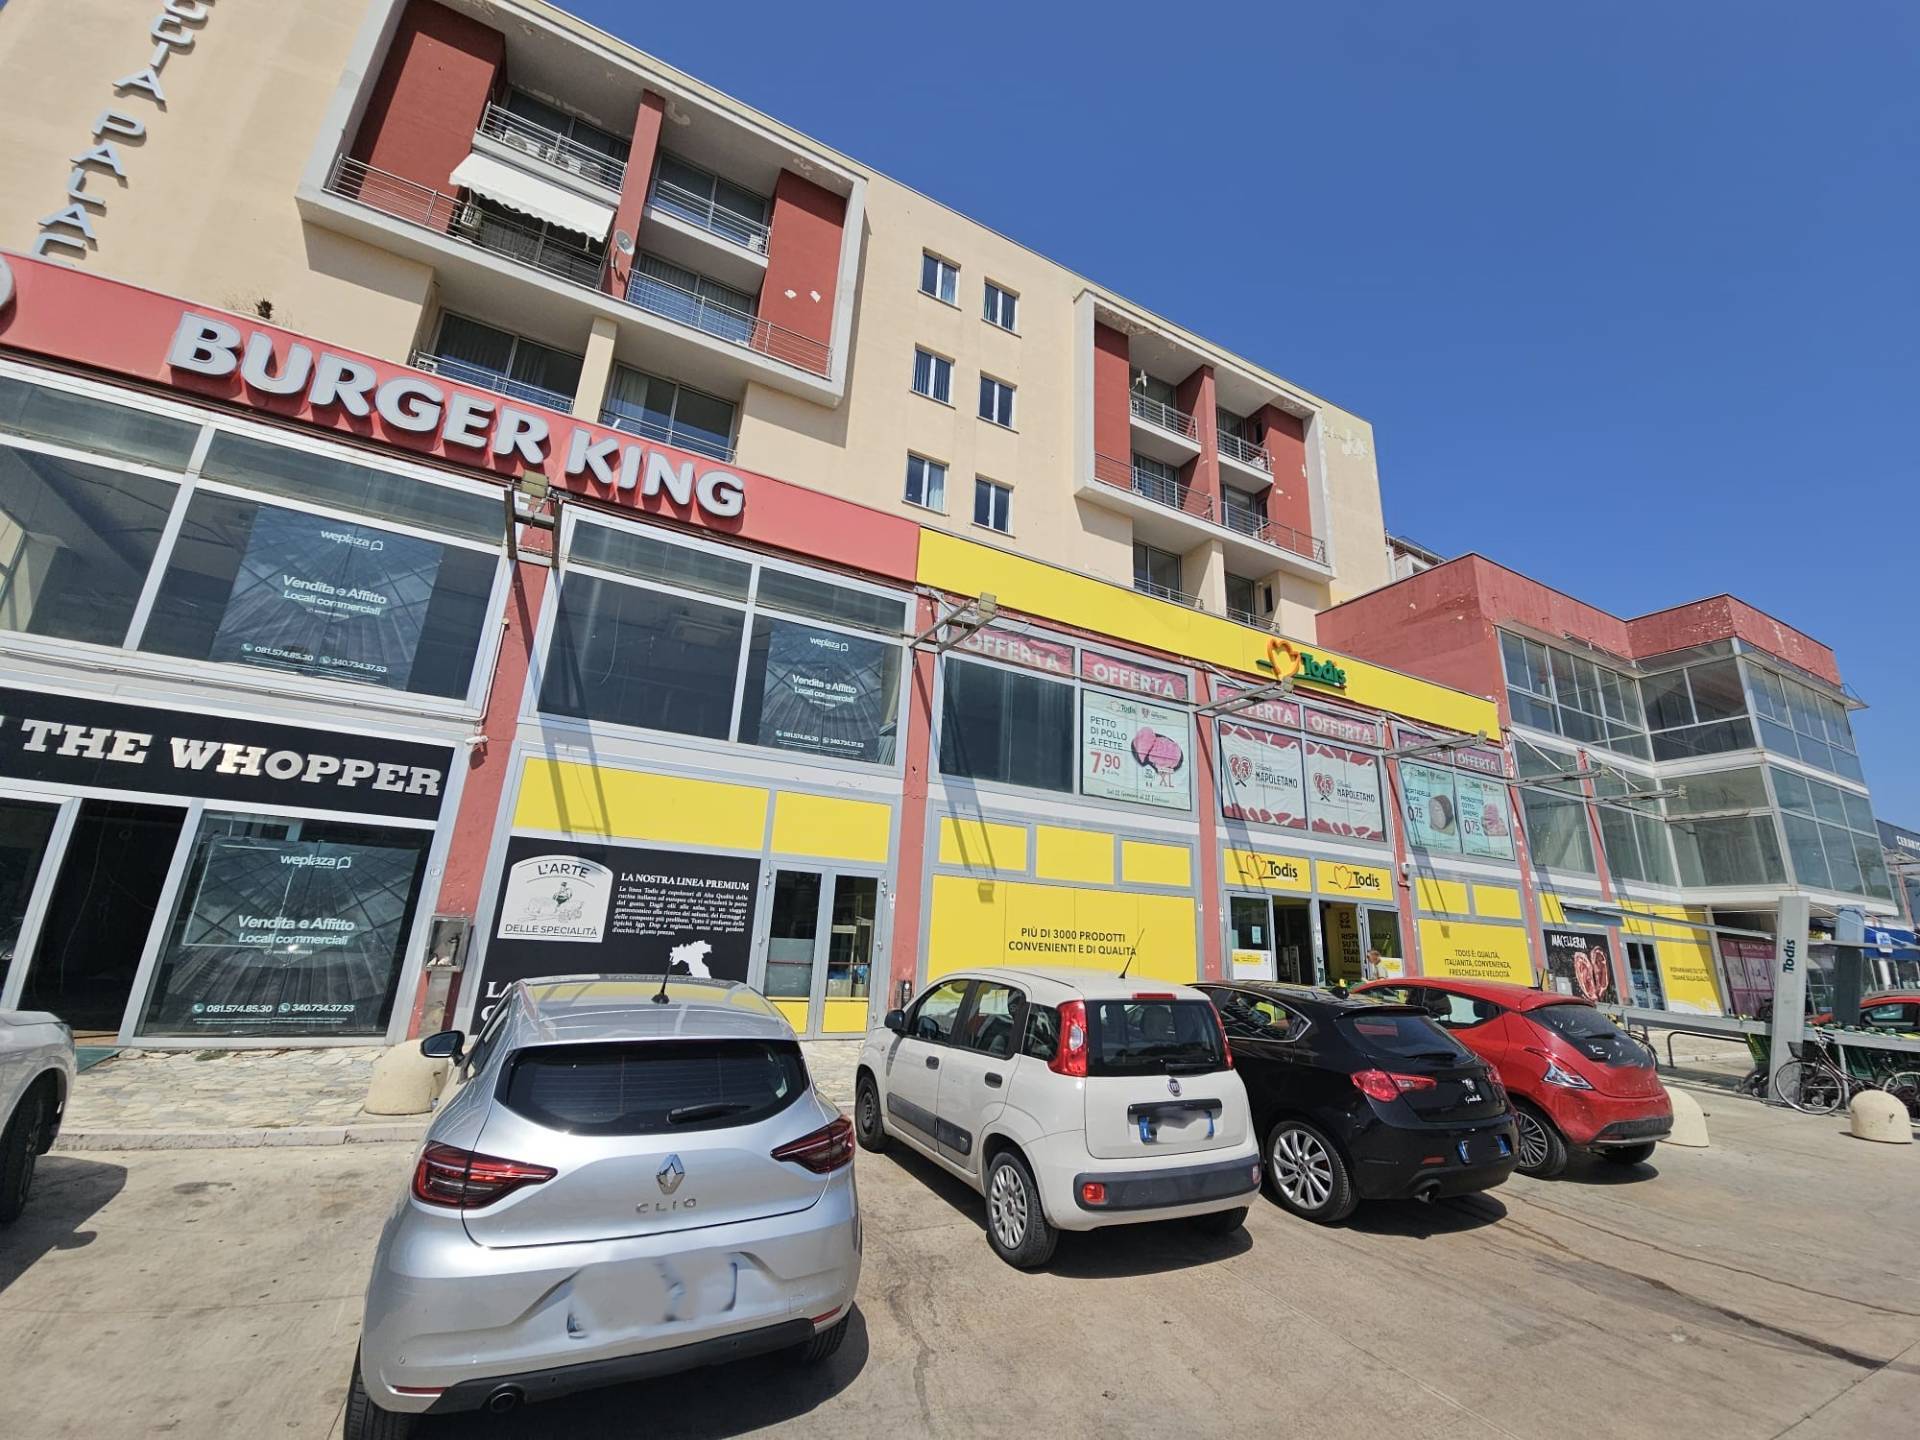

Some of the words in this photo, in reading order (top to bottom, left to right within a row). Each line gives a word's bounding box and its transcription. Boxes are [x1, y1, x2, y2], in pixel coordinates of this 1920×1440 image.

[166, 311, 551, 465] BURGER
[565, 427, 746, 519] KING
[320, 530, 370, 546] weplaza
[283, 575, 335, 595] Vendita
[336, 587, 346, 597] e
[347, 588, 388, 605] Affitto
[283, 590, 316, 604] Locali
[316, 597, 382, 616] commerciali
[809, 637, 840, 649] weplaza
[964, 633, 1061, 673] OFFERTA
[1299, 652, 1346, 685] Todis
[792, 674, 824, 689] Vendita
[831, 683, 857, 694] Affitto
[1094, 662, 1176, 698] OFFERTA
[794, 686, 814, 696] Locali
[814, 691, 855, 703] commerciali
[1090, 716, 1117, 728] PETTO
[1311, 716, 1372, 743] OFFERTA
[1090, 727, 1099, 735] DI
[1101, 729, 1127, 741] POLLO
[1098, 739, 1123, 749] FETTE
[21, 718, 153, 764] THE
[169, 736, 442, 796] WHOPPER
[1457, 753, 1497, 771] OFFERTA
[1160, 771, 1175, 788] XL
[280, 854, 336, 867] weplaza
[538, 863, 591, 879] L'ARTE
[1267, 860, 1299, 879] Todis
[620, 872, 634, 882] LA
[635, 873, 675, 885] NOSTRA
[676, 877, 704, 888] LINEA
[705, 879, 750, 891] PREMIUM
[1353, 872, 1380, 888] Todis
[238, 915, 296, 930] Vendita
[299, 920, 309, 929] e
[310, 918, 355, 931] Affitto
[505, 924, 539, 933] DELLE
[540, 926, 598, 936] SPECIALITÀ
[238, 933, 275, 944] Locali
[276, 935, 349, 945] commerciali
[1021, 926, 1038, 938] PIÙ
[1040, 929, 1050, 938] DI
[1053, 929, 1077, 940] 3000
[1079, 931, 1126, 943] PRODOTTI
[1551, 934, 1587, 949] MACELLERIA
[1008, 941, 1076, 953] CONVENIENTI
[1078, 945, 1084, 953] E
[1086, 945, 1096, 954] DI
[1782, 938, 1796, 973] Todis
[206, 1004, 273, 1013] 081.574.85.30
[291, 1004, 355, 1012] 340.734.37.53
[636, 1198, 697, 1214] CLIO
